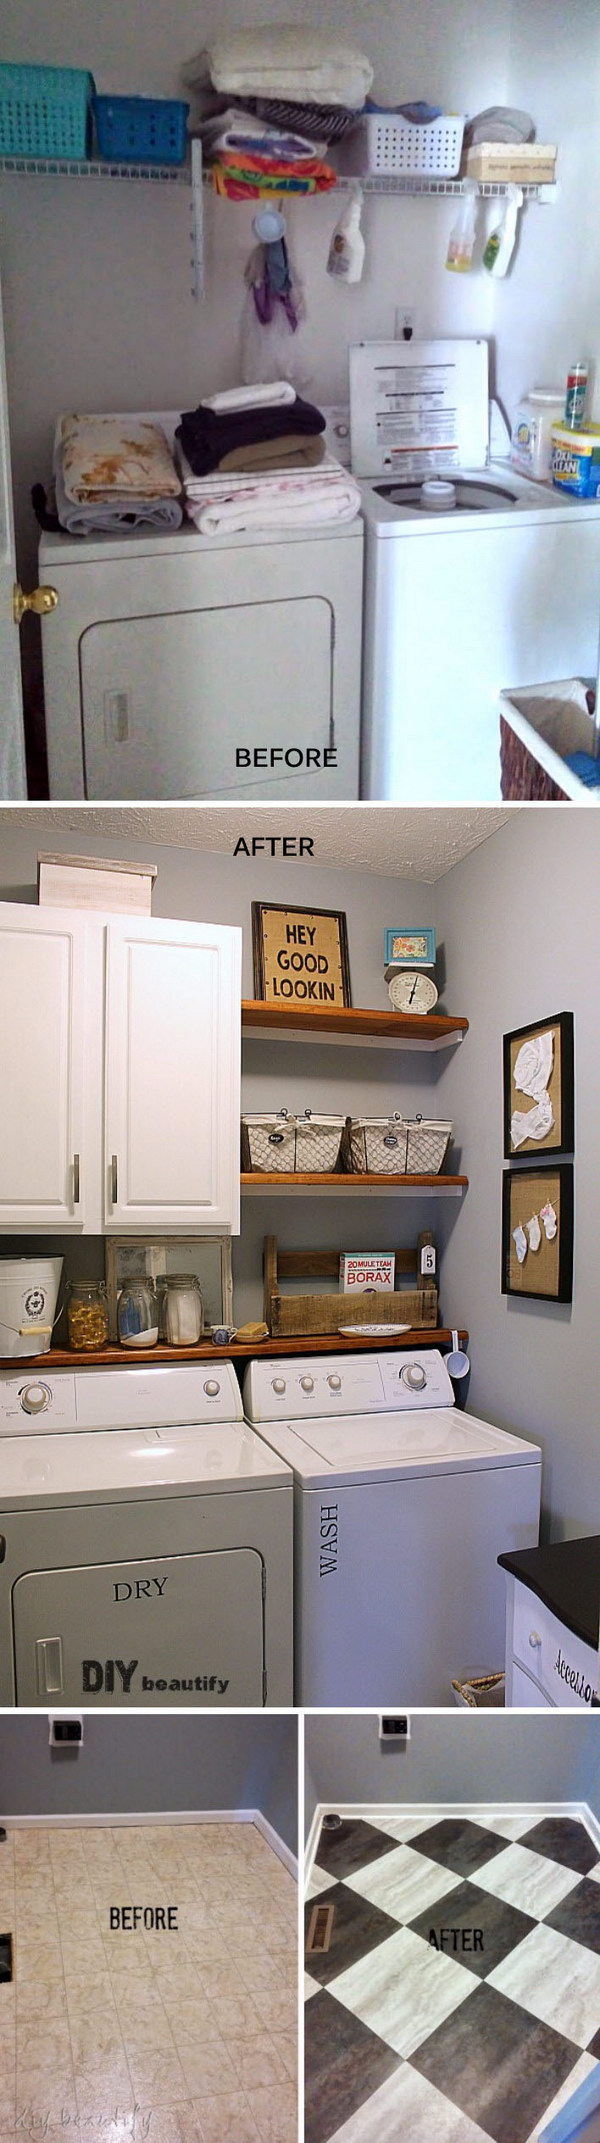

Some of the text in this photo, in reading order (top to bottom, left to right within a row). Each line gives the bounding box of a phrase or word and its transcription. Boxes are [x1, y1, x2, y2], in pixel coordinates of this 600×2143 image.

[285, 924, 317, 946] HEY
[277, 949, 329, 975] GOOD
[272, 977, 336, 1001] LOOKIN
[347, 1261, 357, 1269] 20
[358, 1260, 375, 1268] MULE
[426, 1254, 433, 1268] 5
[347, 1272, 391, 1285] BORAX
[319, 1503, 339, 1578] WASH
[112, 1576, 169, 1603] DRY
